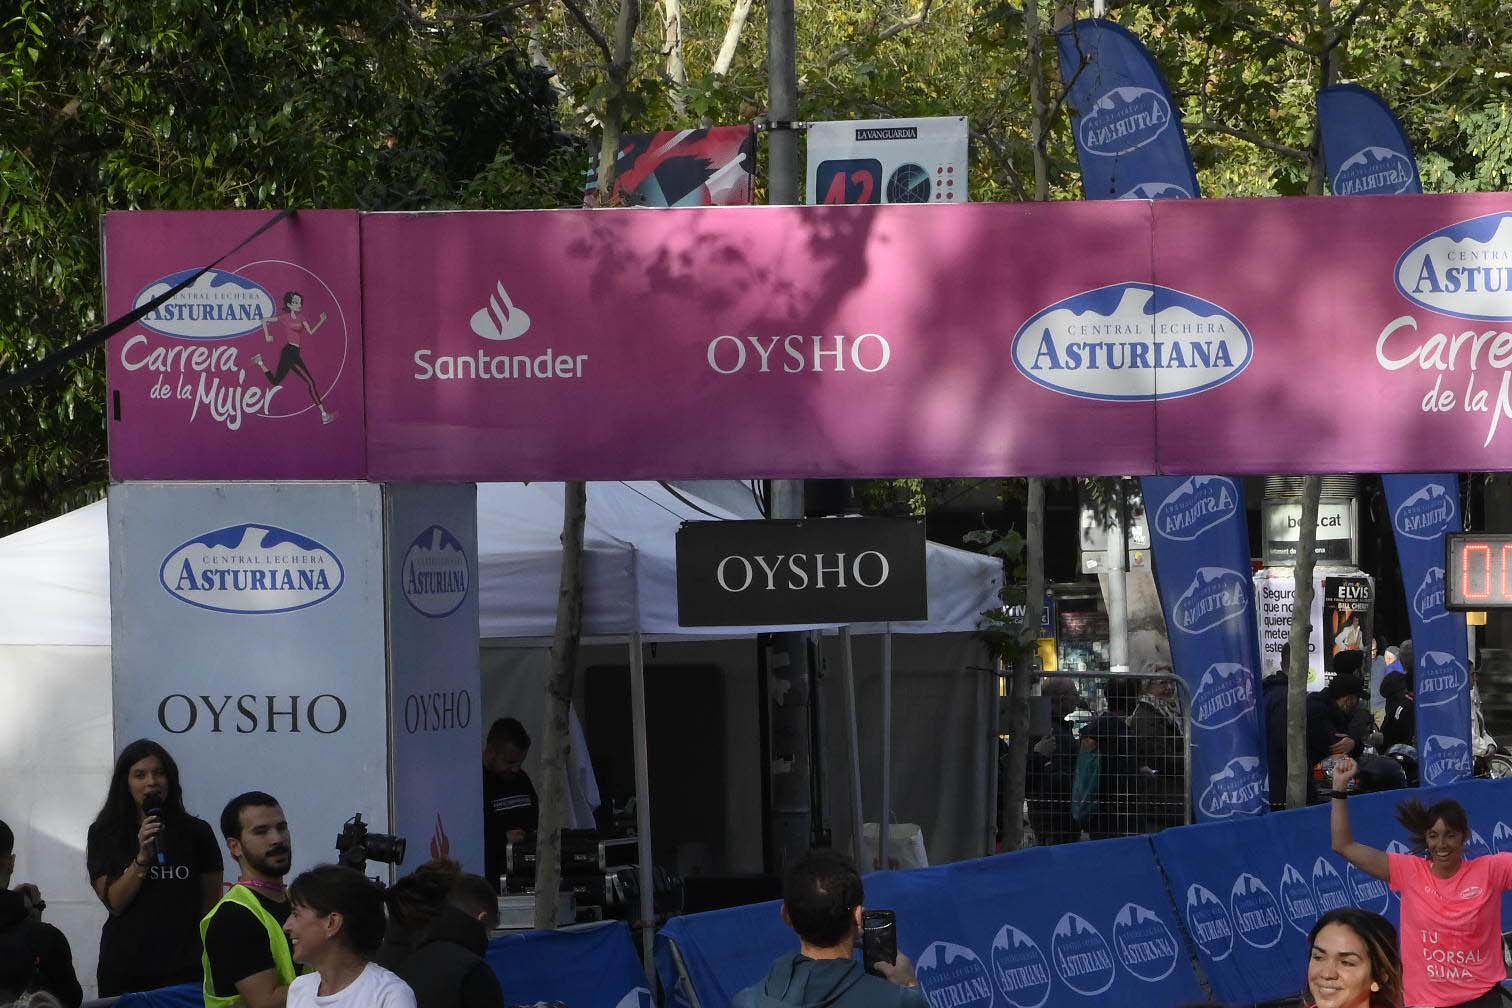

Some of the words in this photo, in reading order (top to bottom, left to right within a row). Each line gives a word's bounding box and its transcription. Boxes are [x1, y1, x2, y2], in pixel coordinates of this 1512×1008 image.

[867, 128, 917, 139] VANGUARDIA
[1067, 323, 1142, 335] CENTRAL
[1150, 322, 1226, 334] LECHERA
[120, 334, 239, 371] Carrera
[414, 348, 588, 380] Santander
[707, 333, 891, 374] OYSHO
[1030, 327, 1234, 370] ASTURIANA
[150, 374, 172, 399] de
[177, 371, 192, 399] la
[190, 368, 283, 430] Mujer
[1421, 373, 1456, 412] de
[1464, 371, 1488, 412] la
[175, 557, 331, 591] ASTURIANA
[203, 555, 260, 565] CENTRAL
[265, 554, 324, 564] LECHERA
[716, 550, 891, 593] OYSHO
[407, 559, 465, 595] ASTURIANA
[1338, 586, 1369, 599] ELVIS
[1263, 602, 1280, 614] que
[157, 694, 347, 734] OYSHO
[404, 689, 471, 735] OYSHO
[150, 865, 189, 880] SHO
[1421, 930, 1438, 944] TU
[1424, 947, 1482, 963] DORSAL
[1426, 965, 1473, 978] SUMA
